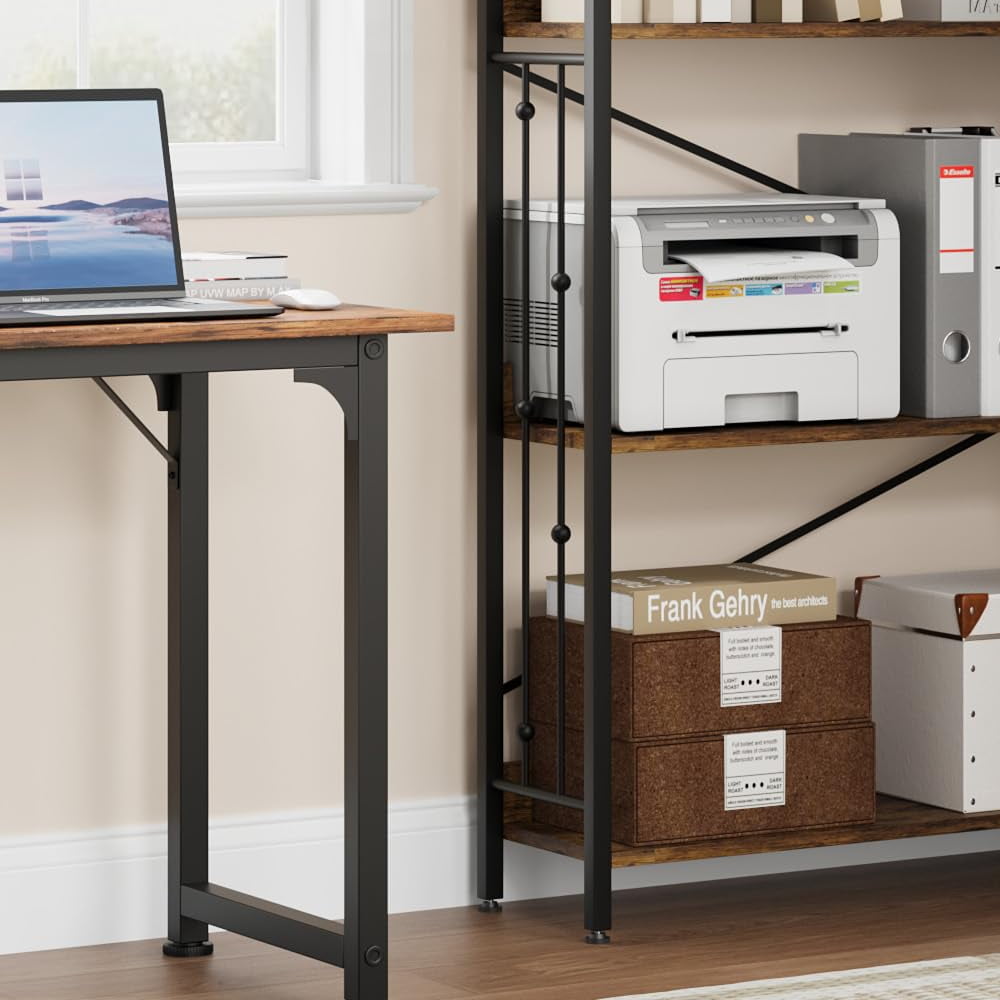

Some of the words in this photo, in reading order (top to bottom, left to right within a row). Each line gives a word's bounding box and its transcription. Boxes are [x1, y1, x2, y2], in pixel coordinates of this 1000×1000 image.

[184, 288, 198, 296] AP
[200, 288, 224, 298] UVW
[226, 288, 248, 297] MAP
[250, 288, 264, 296] BY
[648, 592, 703, 622] Frank
[709, 588, 768, 622] Gehry
[771, 598, 782, 608] the
[782, 597, 798, 608] best
